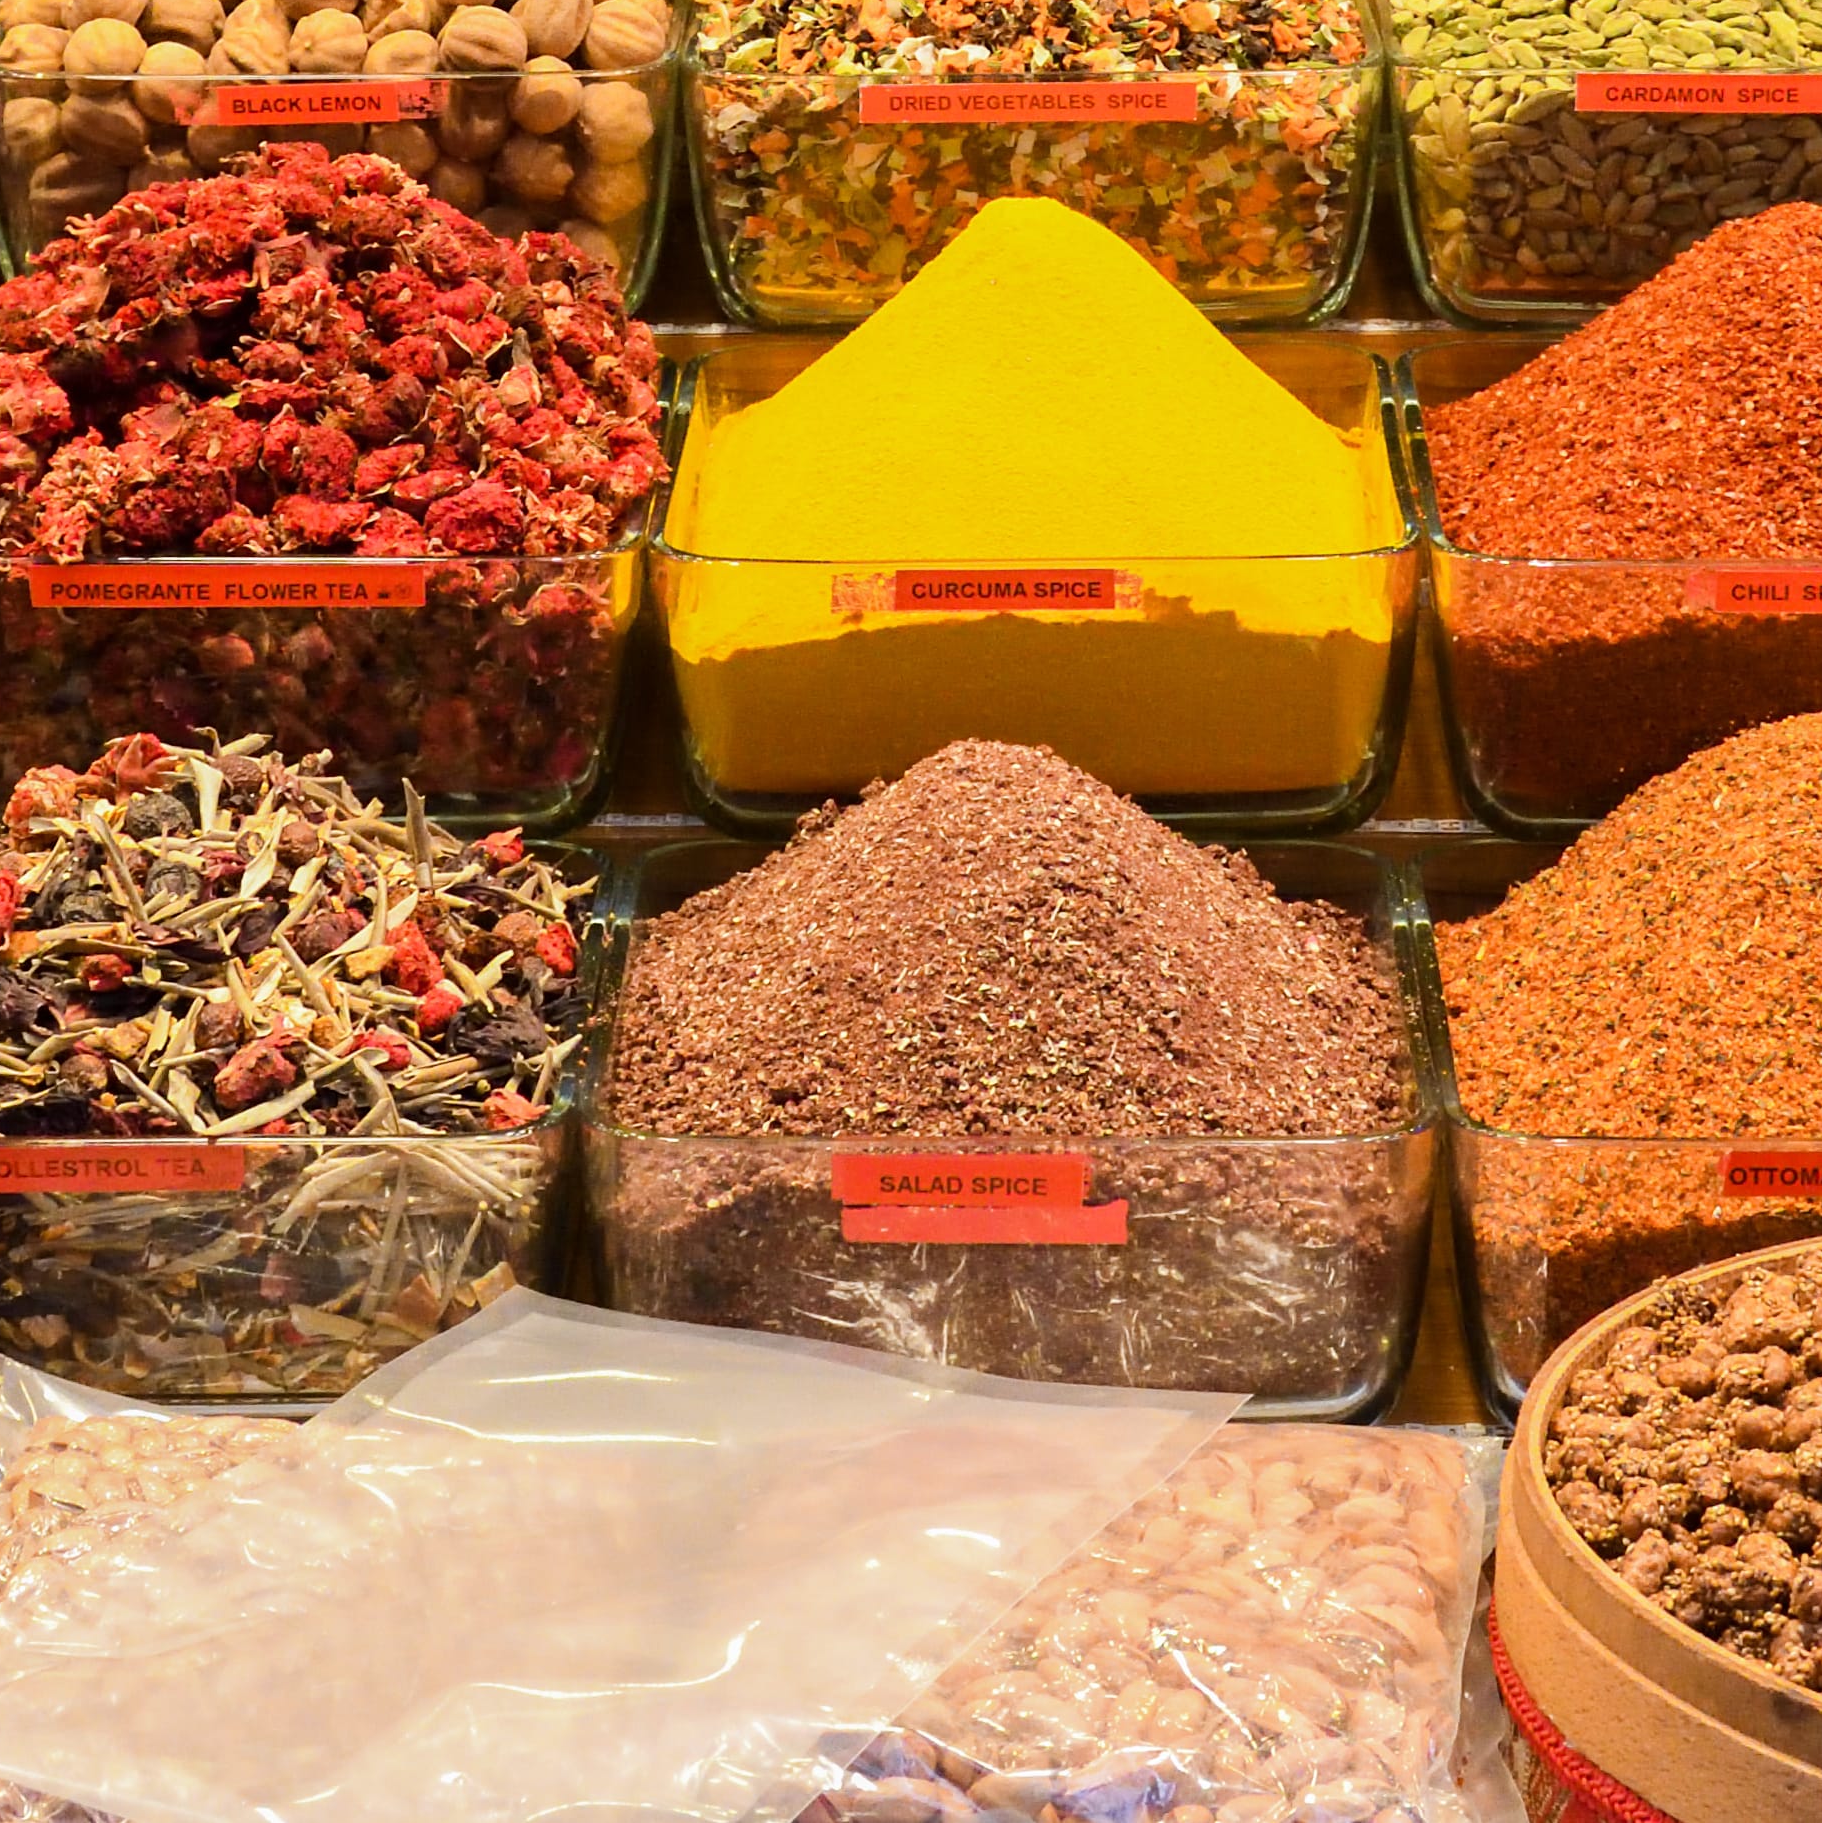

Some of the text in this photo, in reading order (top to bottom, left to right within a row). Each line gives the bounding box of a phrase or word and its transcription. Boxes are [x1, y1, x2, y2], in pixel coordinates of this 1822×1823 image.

[889, 93, 1168, 111] DRIED VEGETABLES SPICE
[1605, 86, 1799, 103] CARDAMON SPICE
[232, 95, 382, 114] BLACK LEMON
[50, 583, 368, 601] POMEGRANTE FLOWER TEA
[911, 581, 1102, 599] CURCUMA SPICE
[1731, 584, 1790, 601] CHILI
[155, 1158, 206, 1176] TEA
[879, 1176, 1048, 1196] SALAD SPICE
